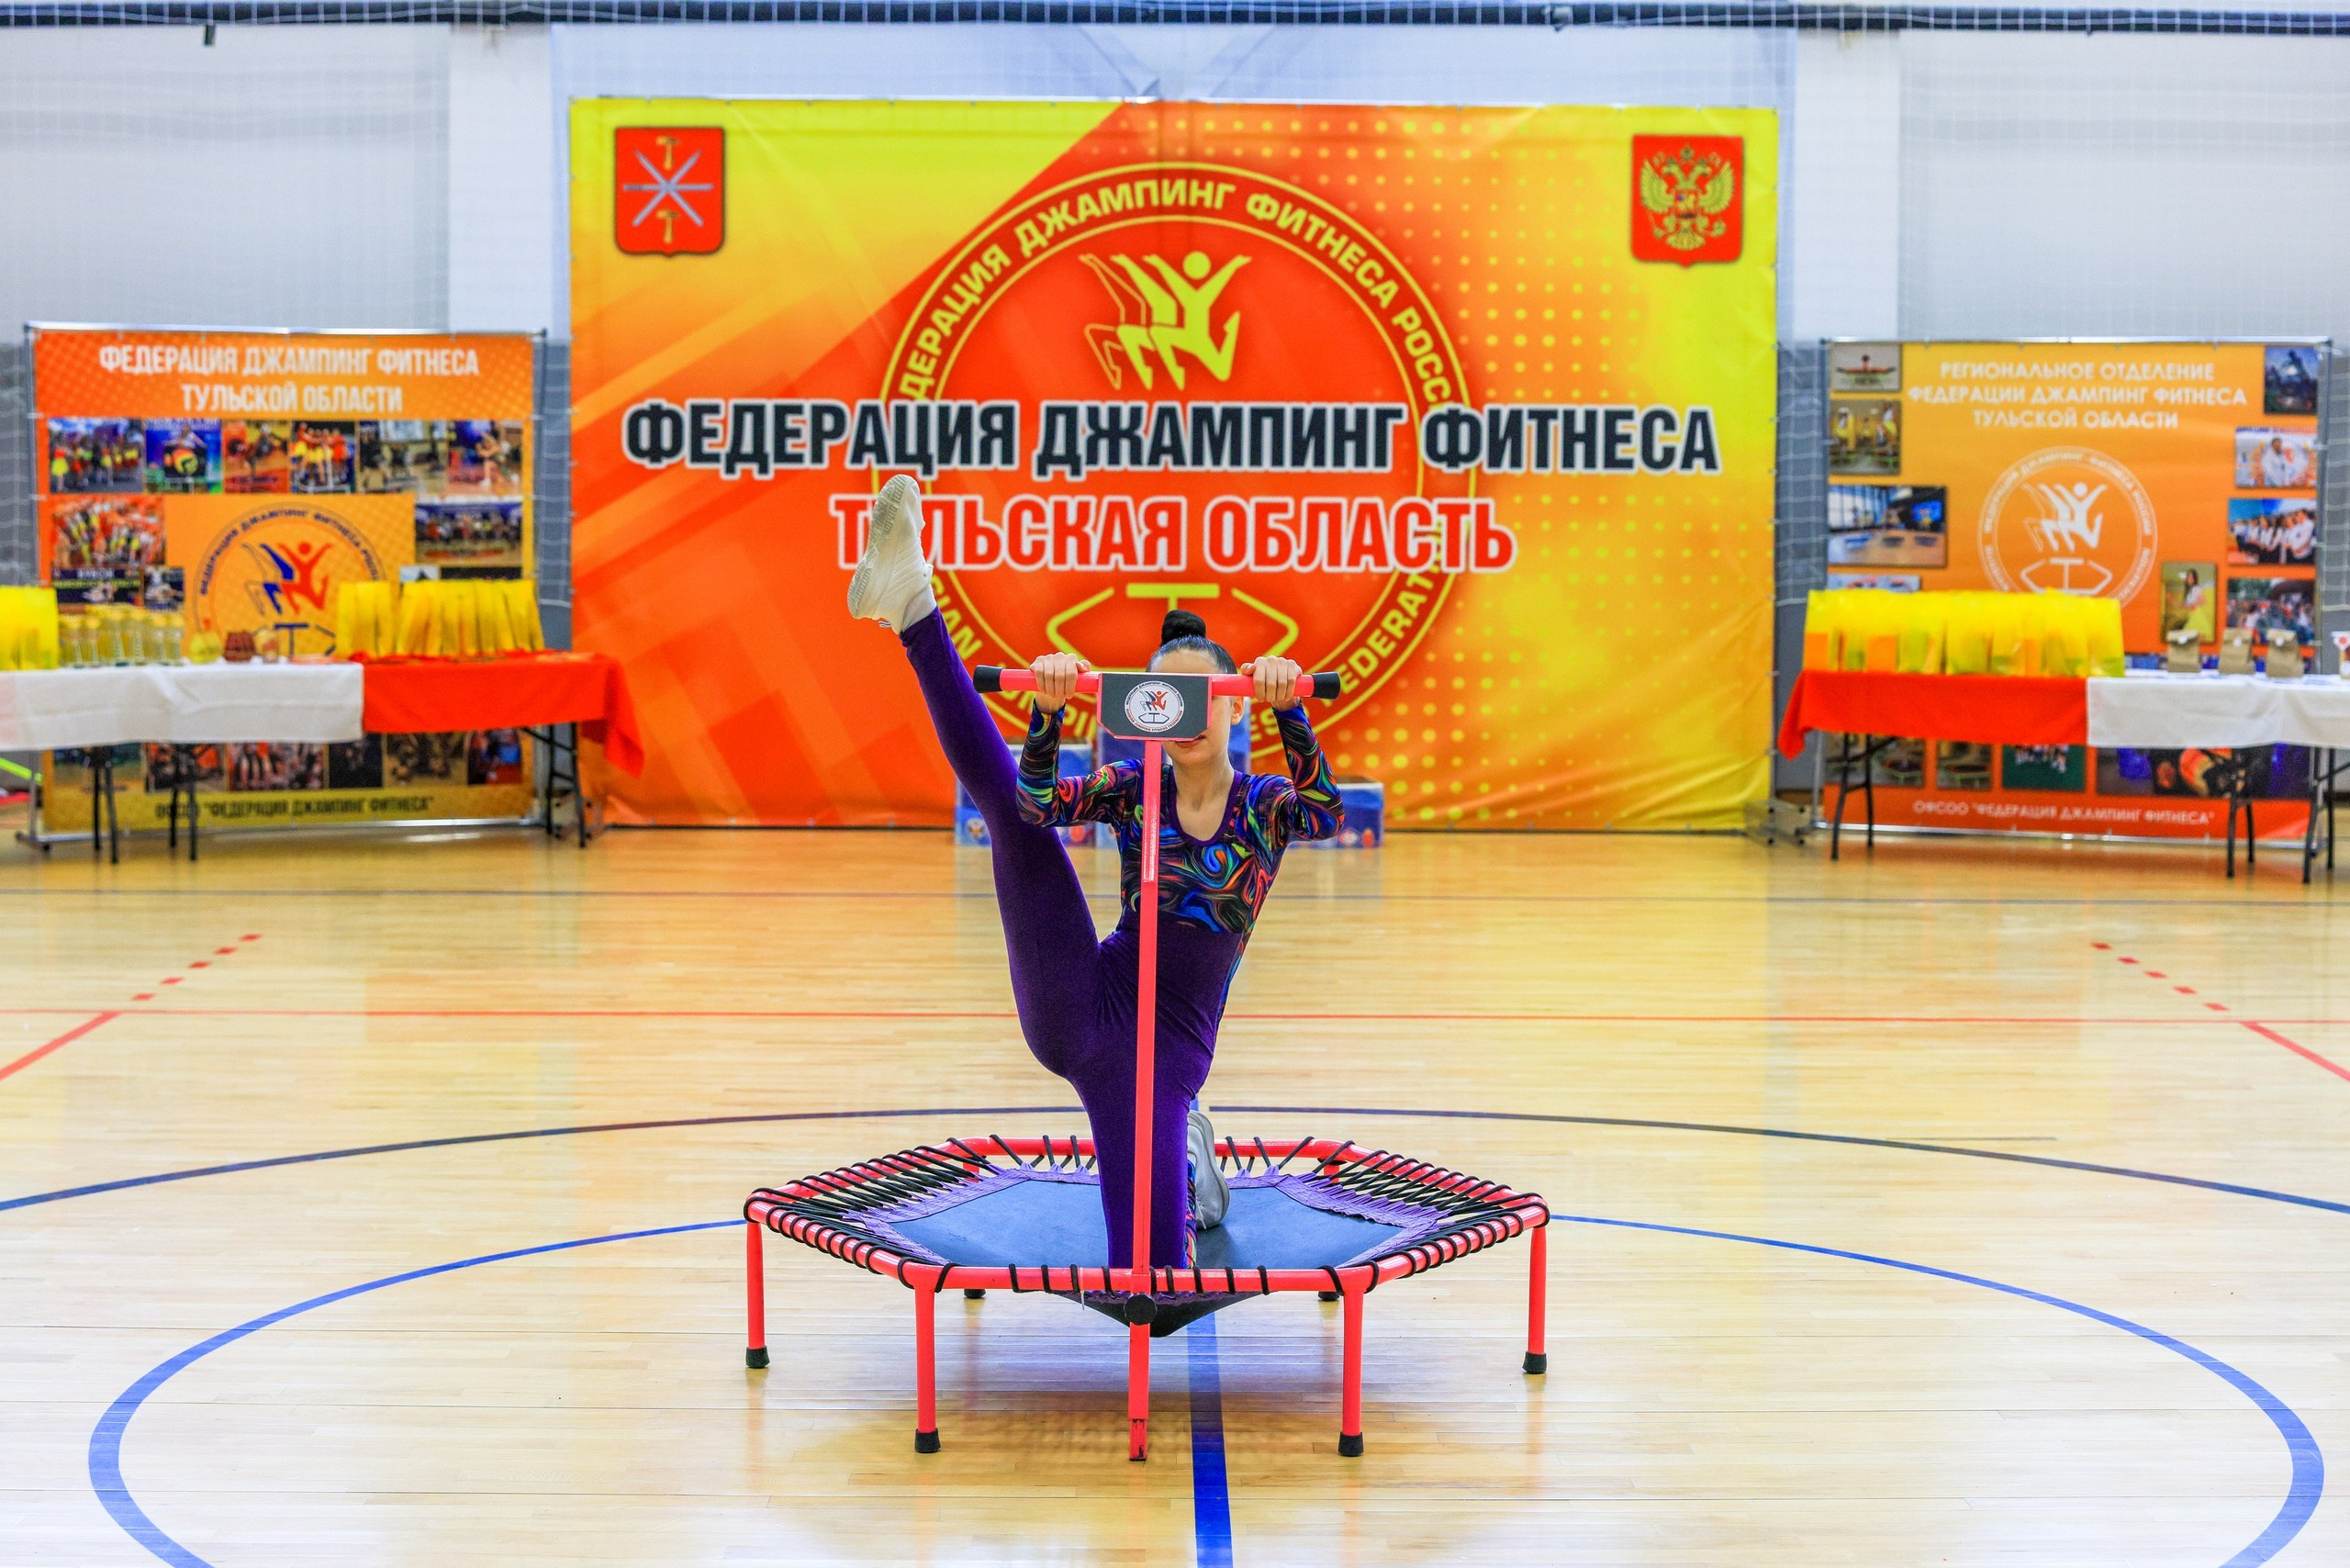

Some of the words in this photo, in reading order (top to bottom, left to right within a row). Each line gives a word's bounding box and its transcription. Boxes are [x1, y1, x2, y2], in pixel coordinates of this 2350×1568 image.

[899, 242, 1012, 401] ДЕРАЦИЯ
[1013, 177, 1237, 258] ДЖАМПИНГ
[1245, 192, 1400, 310] ФИТНЕСА
[1391, 305, 1452, 404] РОСС
[99, 344, 238, 375] ФЕДЕРАЦИЯ
[241, 346, 373, 376] ДЖАМПИНГ
[376, 348, 480, 376] ФИТНЕСА
[1940, 361, 2094, 380] РЕГИОНАЛЬНОЕ
[2098, 362, 2215, 382] ОТДЕЛЕНИЕ
[181, 381, 297, 412] ТУЛЬСКОЙ
[303, 385, 404, 413] ОБЛАСТИ
[1908, 385, 2026, 405] ФЕДЕРАЦИИ
[2030, 386, 2149, 406] ДЖАМПИНГ
[2153, 386, 2247, 407] ФИТНЕСА
[1974, 407, 2077, 429] ТУЛЬСКОЙ
[2083, 409, 2178, 430] ОБЛАСТИ
[624, 400, 1017, 477] ФЕДЕРАЦИЯ
[1035, 403, 1404, 478] ДЖАМПИНГ
[1423, 405, 1719, 474] ФИТНЕСА
[832, 497, 1184, 568] ТЛЬСКАЯ
[1206, 498, 1515, 571] ОБЛАСТЬ
